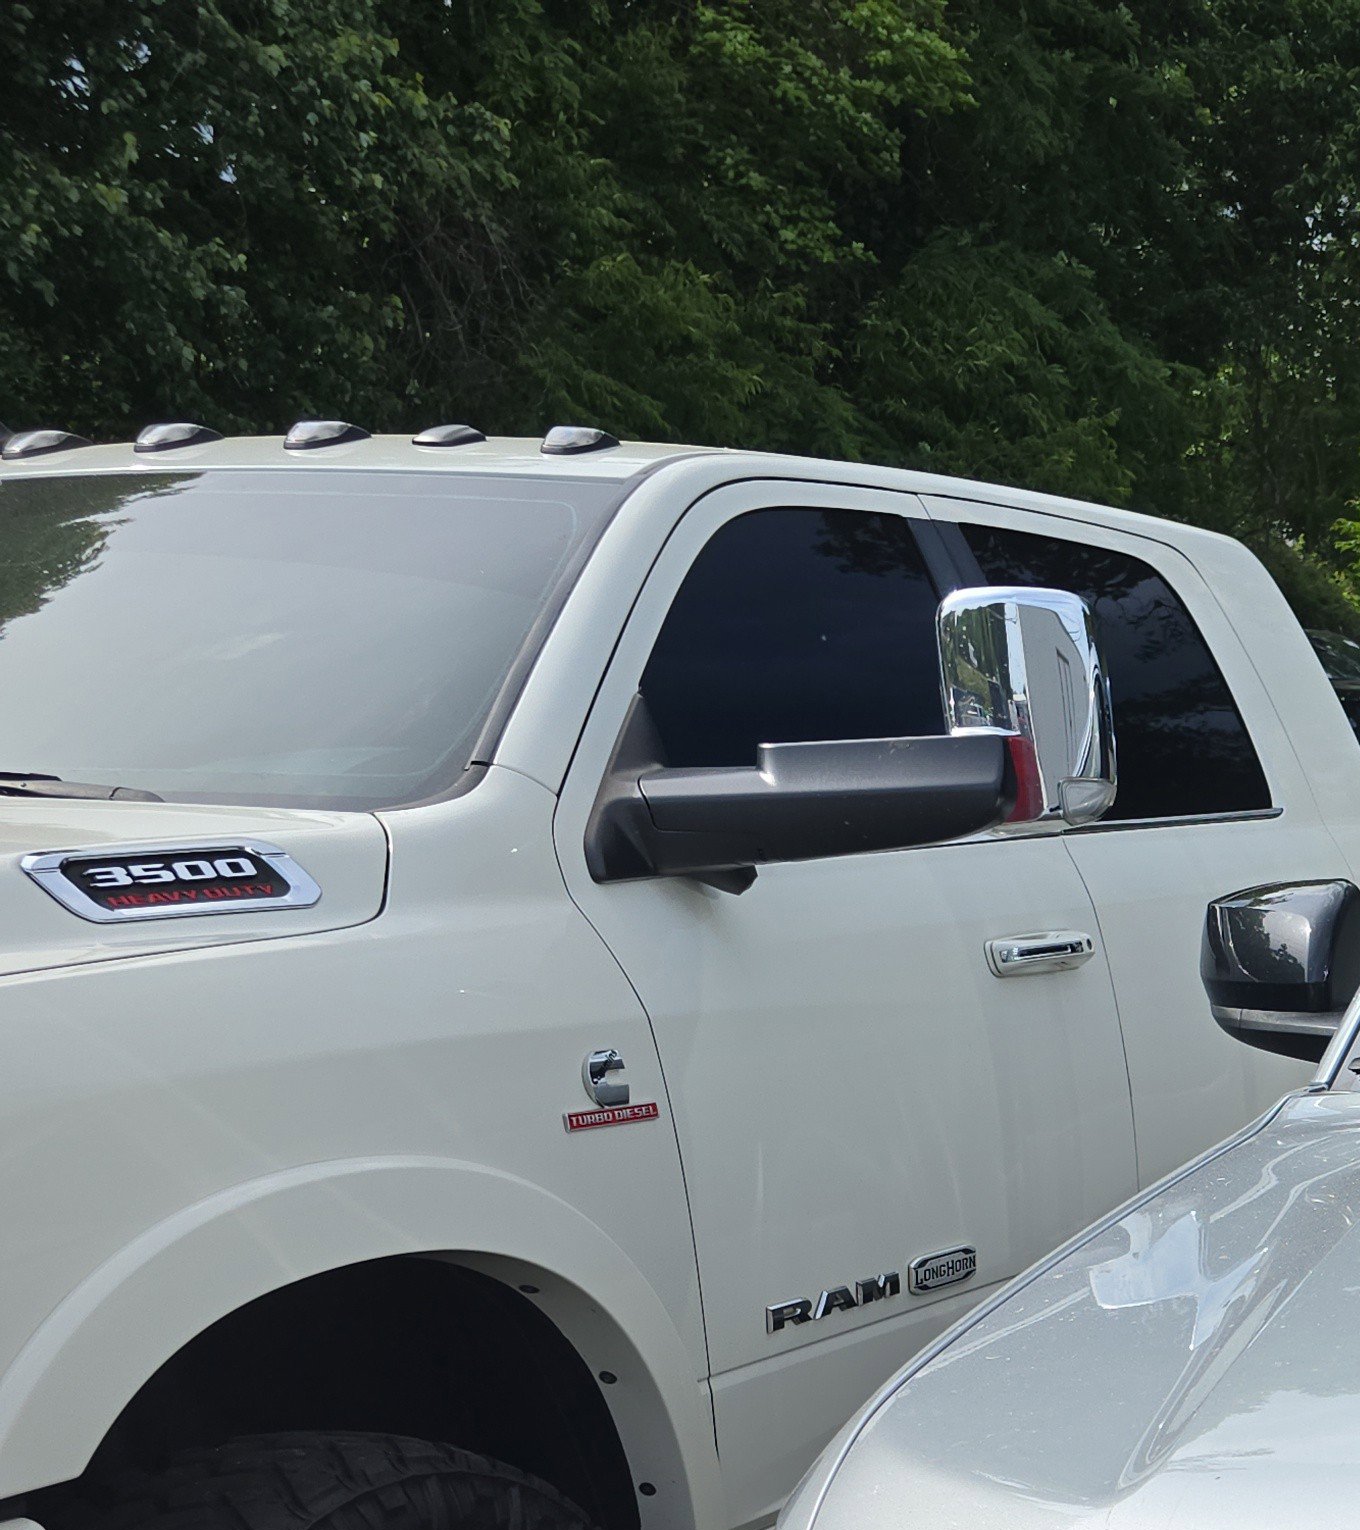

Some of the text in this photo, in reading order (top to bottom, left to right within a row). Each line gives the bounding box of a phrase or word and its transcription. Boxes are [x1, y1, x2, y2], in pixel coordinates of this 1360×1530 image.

[84, 858, 258, 887] 3500
[107, 884, 274, 909] HEAVY DUTY
[570, 1106, 657, 1126] TURBO DIESEL
[766, 1272, 900, 1334] RAM
